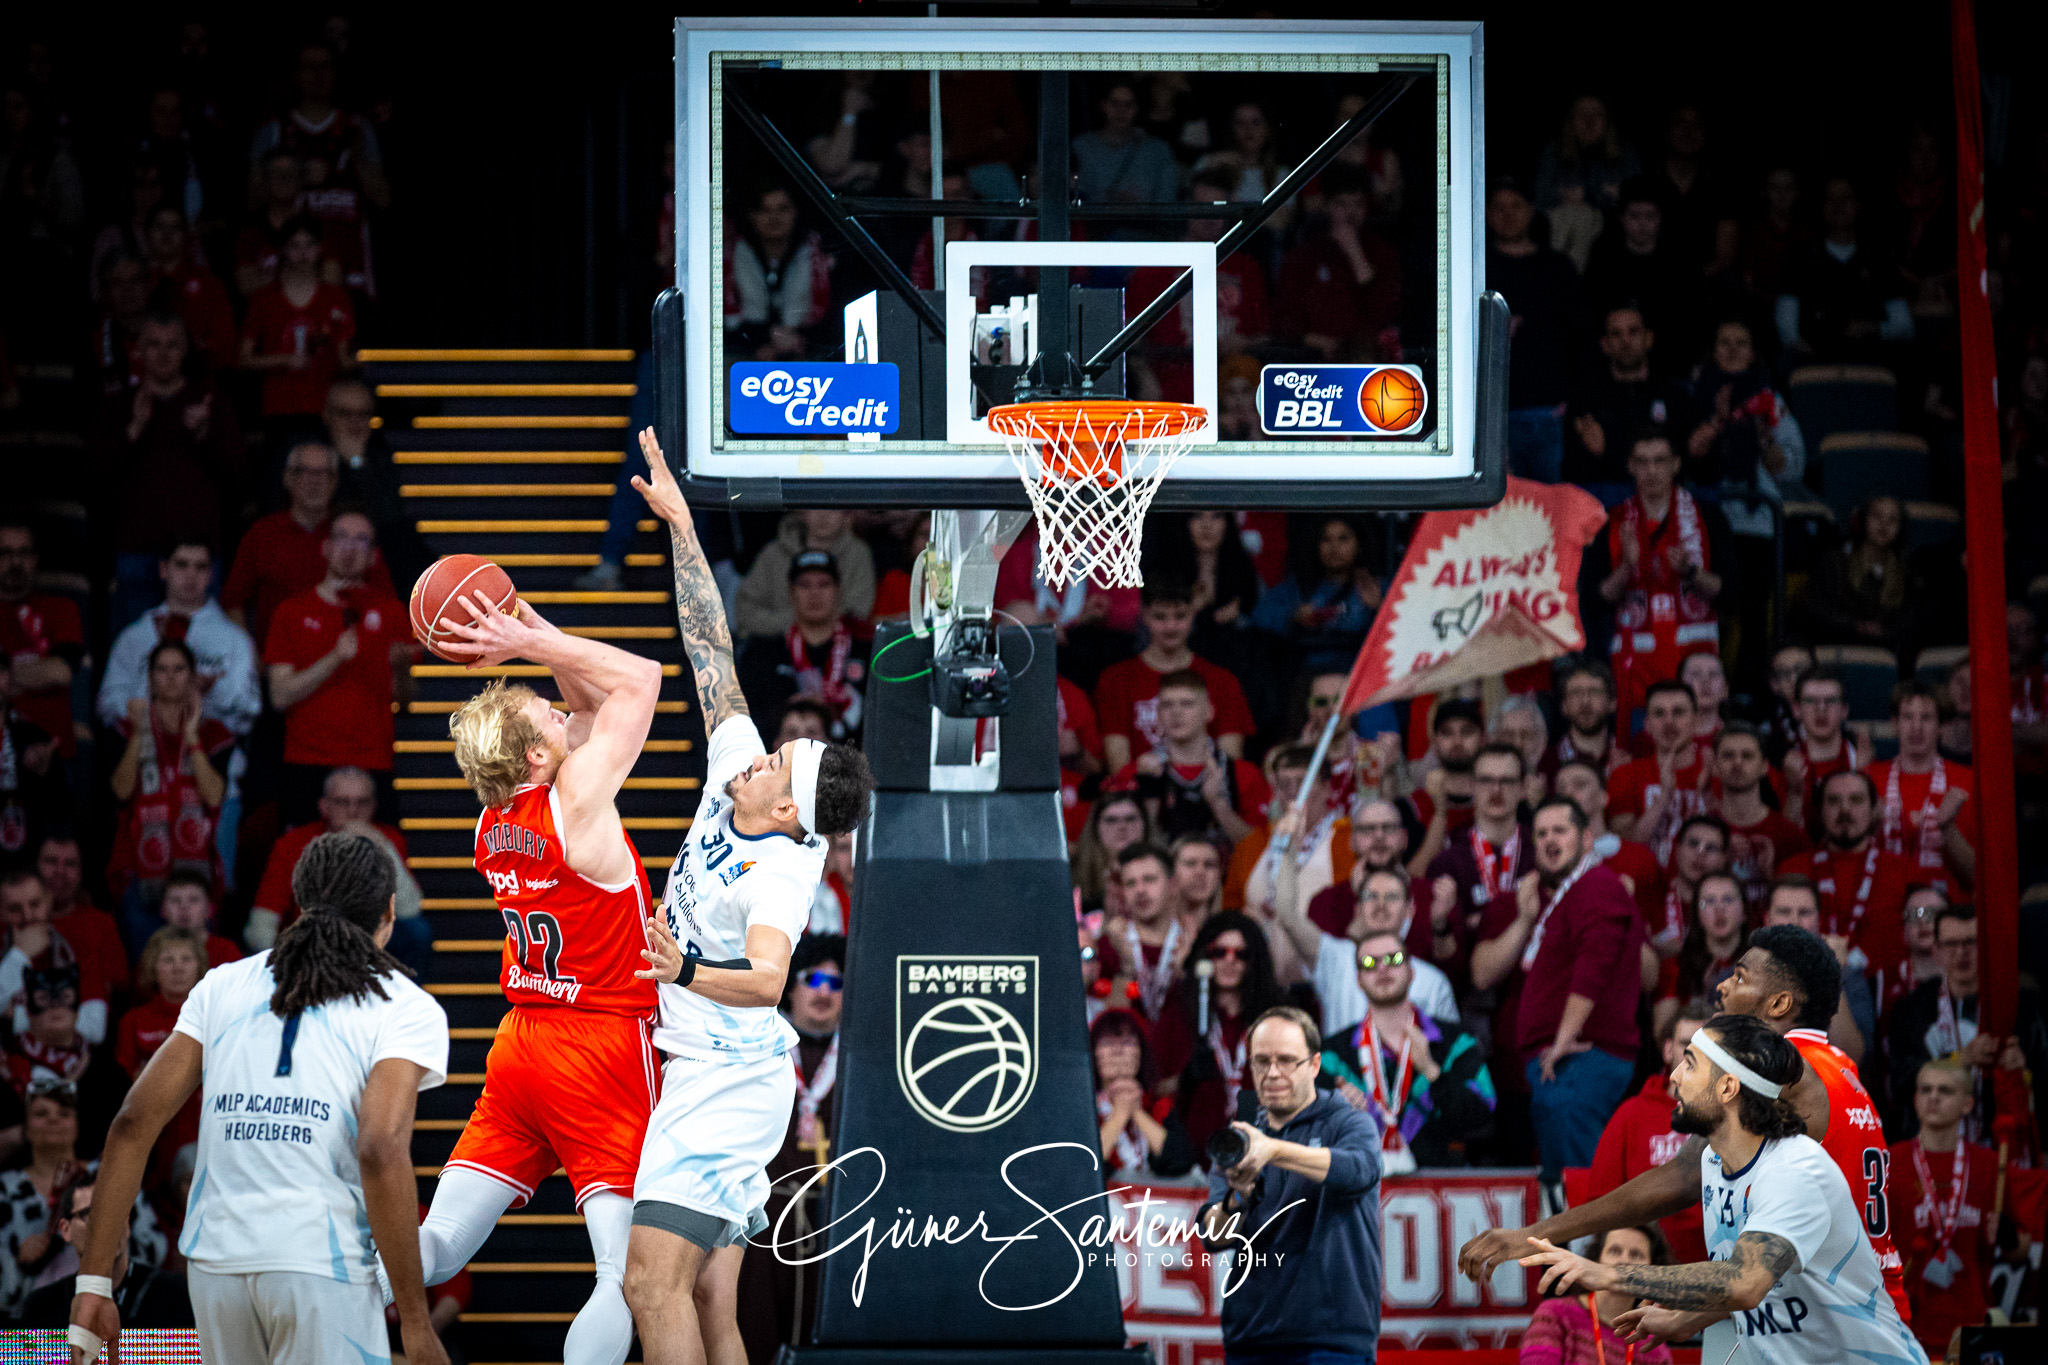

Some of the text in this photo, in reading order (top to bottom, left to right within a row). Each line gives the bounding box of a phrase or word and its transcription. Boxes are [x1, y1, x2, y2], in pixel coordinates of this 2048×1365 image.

[1294, 385, 1344, 399] Credit
[784, 398, 889, 427] Credit
[1274, 400, 1343, 427] BBL
[701, 828, 733, 870] 30
[502, 908, 577, 984] 22
[908, 965, 1027, 981] BAMBERG
[908, 982, 1027, 994] BASKETS
[214, 1093, 331, 1122] MLP ACADEMICS
[224, 1122, 312, 1145] HEIDELBERG
[1863, 1147, 1891, 1239] 3
[1743, 1296, 1809, 1337] MLP
